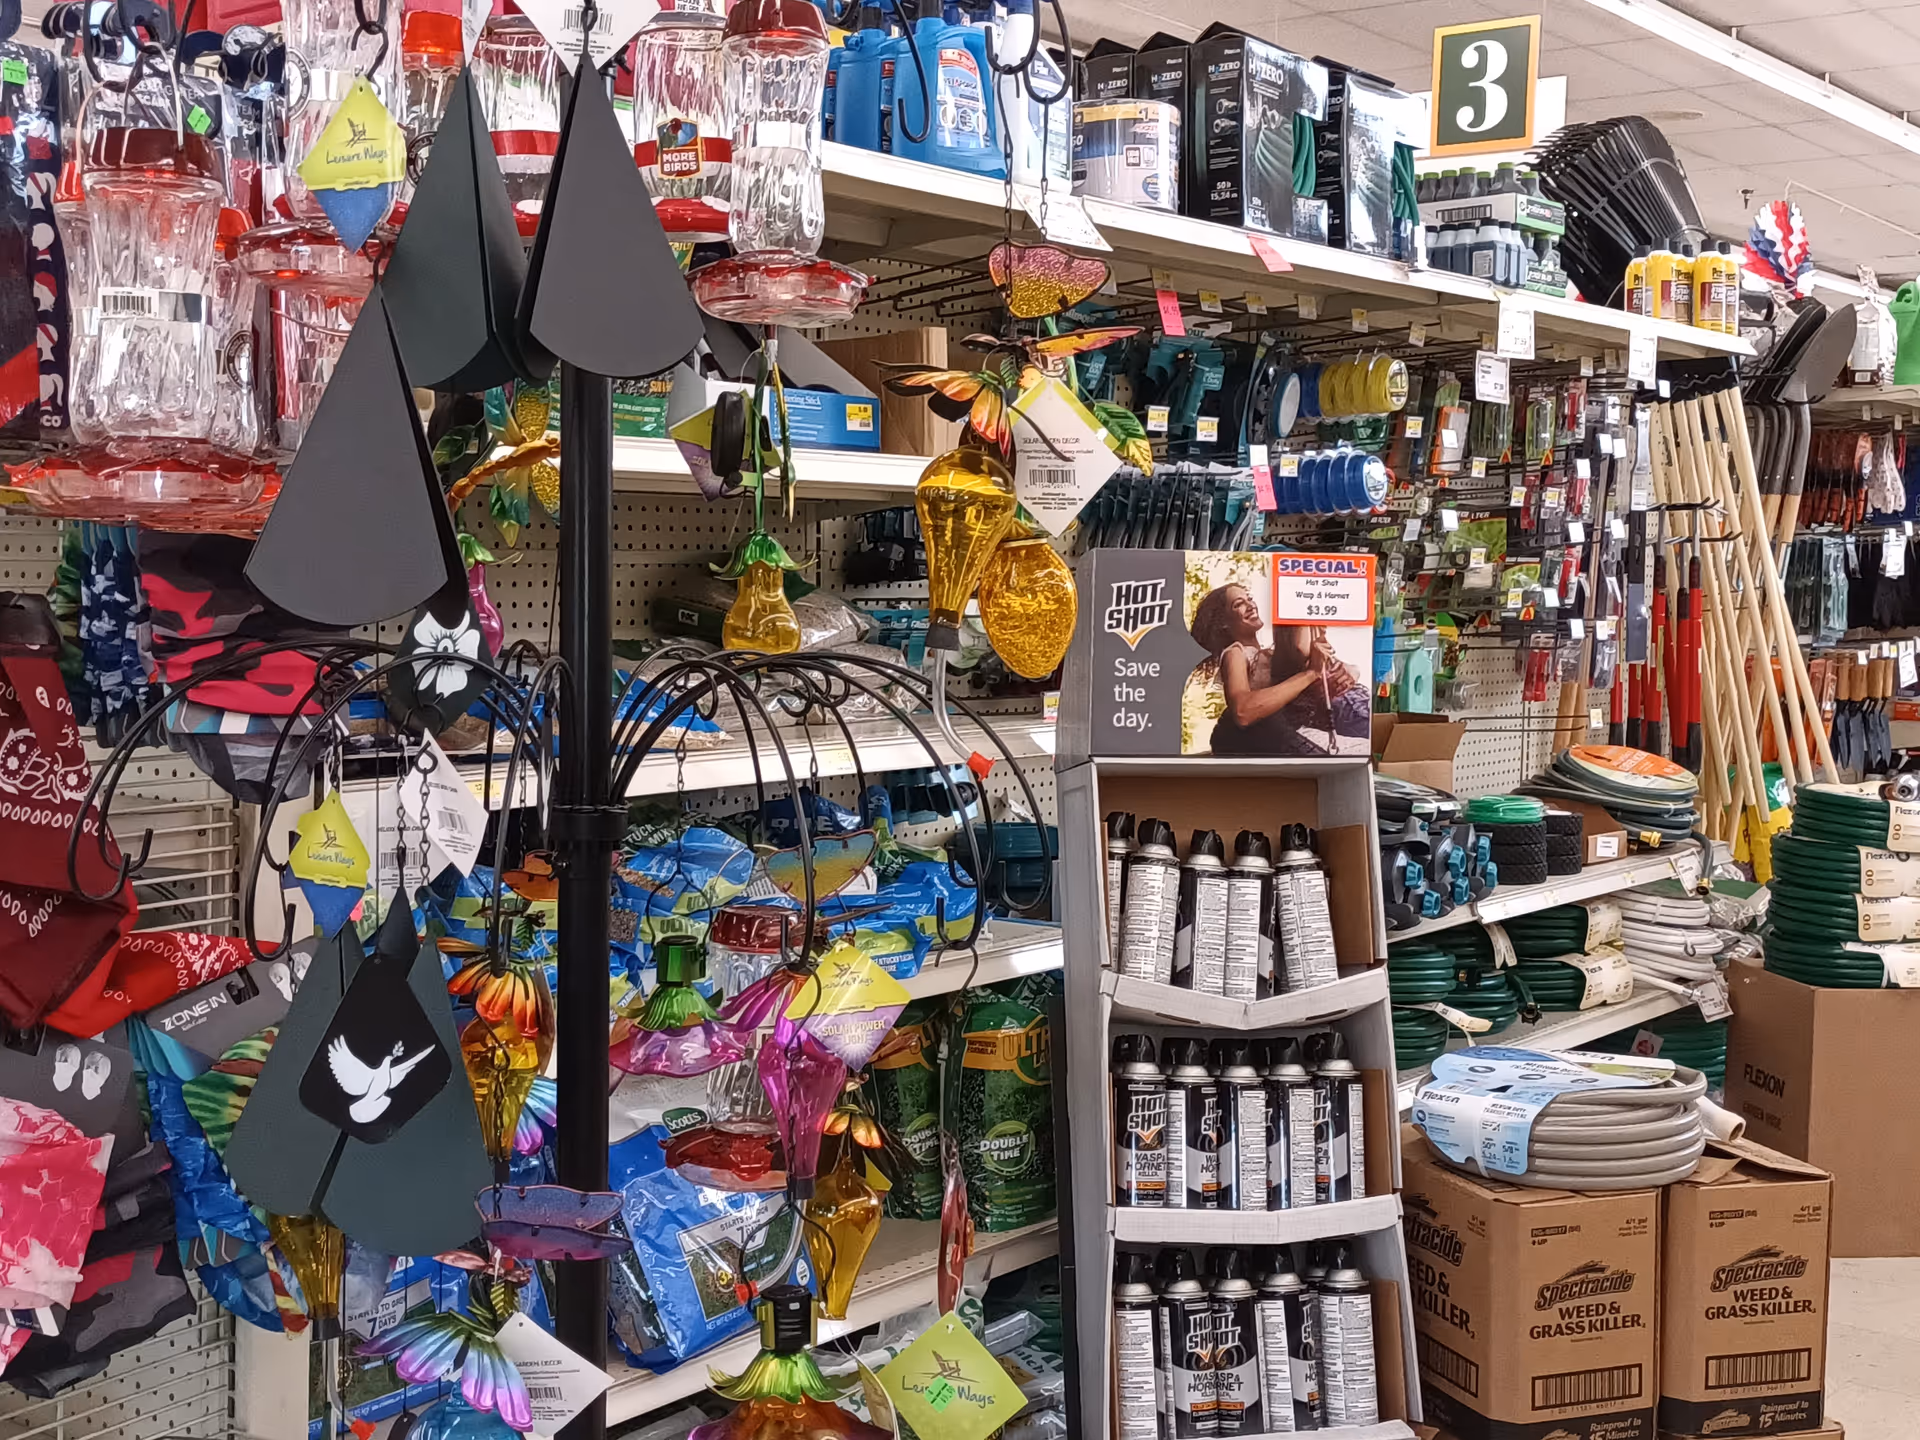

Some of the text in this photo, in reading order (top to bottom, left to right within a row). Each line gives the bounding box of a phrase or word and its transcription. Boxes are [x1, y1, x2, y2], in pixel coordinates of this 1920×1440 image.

[1456, 39, 1509, 133] 3
[663, 152, 696, 162] MORE
[664, 162, 697, 171] BIRDS
[1279, 558, 1367, 575] SPECIAL!
[1113, 579, 1165, 608] HOT
[1106, 602, 1171, 634] SHOT
[1306, 604, 1337, 616] $3.99
[1114, 658, 1160, 677] Save
[1113, 683, 1146, 702] the
[1113, 707, 1153, 732] day.
[1743, 1063, 1786, 1100] FLEXON
[1131, 1094, 1166, 1114] HOT
[1421, 1090, 1461, 1105] Flexon
[664, 1111, 703, 1130] Scotts
[1127, 1111, 1168, 1131] SHOT
[980, 1133, 1029, 1151] DOUBLE
[991, 1147, 1021, 1161] TIME
[1126, 1161, 1168, 1172] HORNET
[1710, 1257, 1809, 1292] Spectracide
[1534, 1271, 1637, 1311] Spectracide
[1734, 1286, 1793, 1302] WEED &
[1558, 1301, 1621, 1321] WEED &
[1705, 1300, 1813, 1321] GRASS KILLER
[367, 1315, 397, 1338] 7 DAYS
[1529, 1313, 1642, 1340] GRASS KILLER
[957, 1385, 996, 1409] Ways
[1759, 1402, 1800, 1415] Rainproof
[1590, 1418, 1632, 1432] Rainproof
[1758, 1412, 1775, 1430] 15
[1774, 1411, 1808, 1423] Minutes
[1605, 1429, 1640, 1440] Minutes
